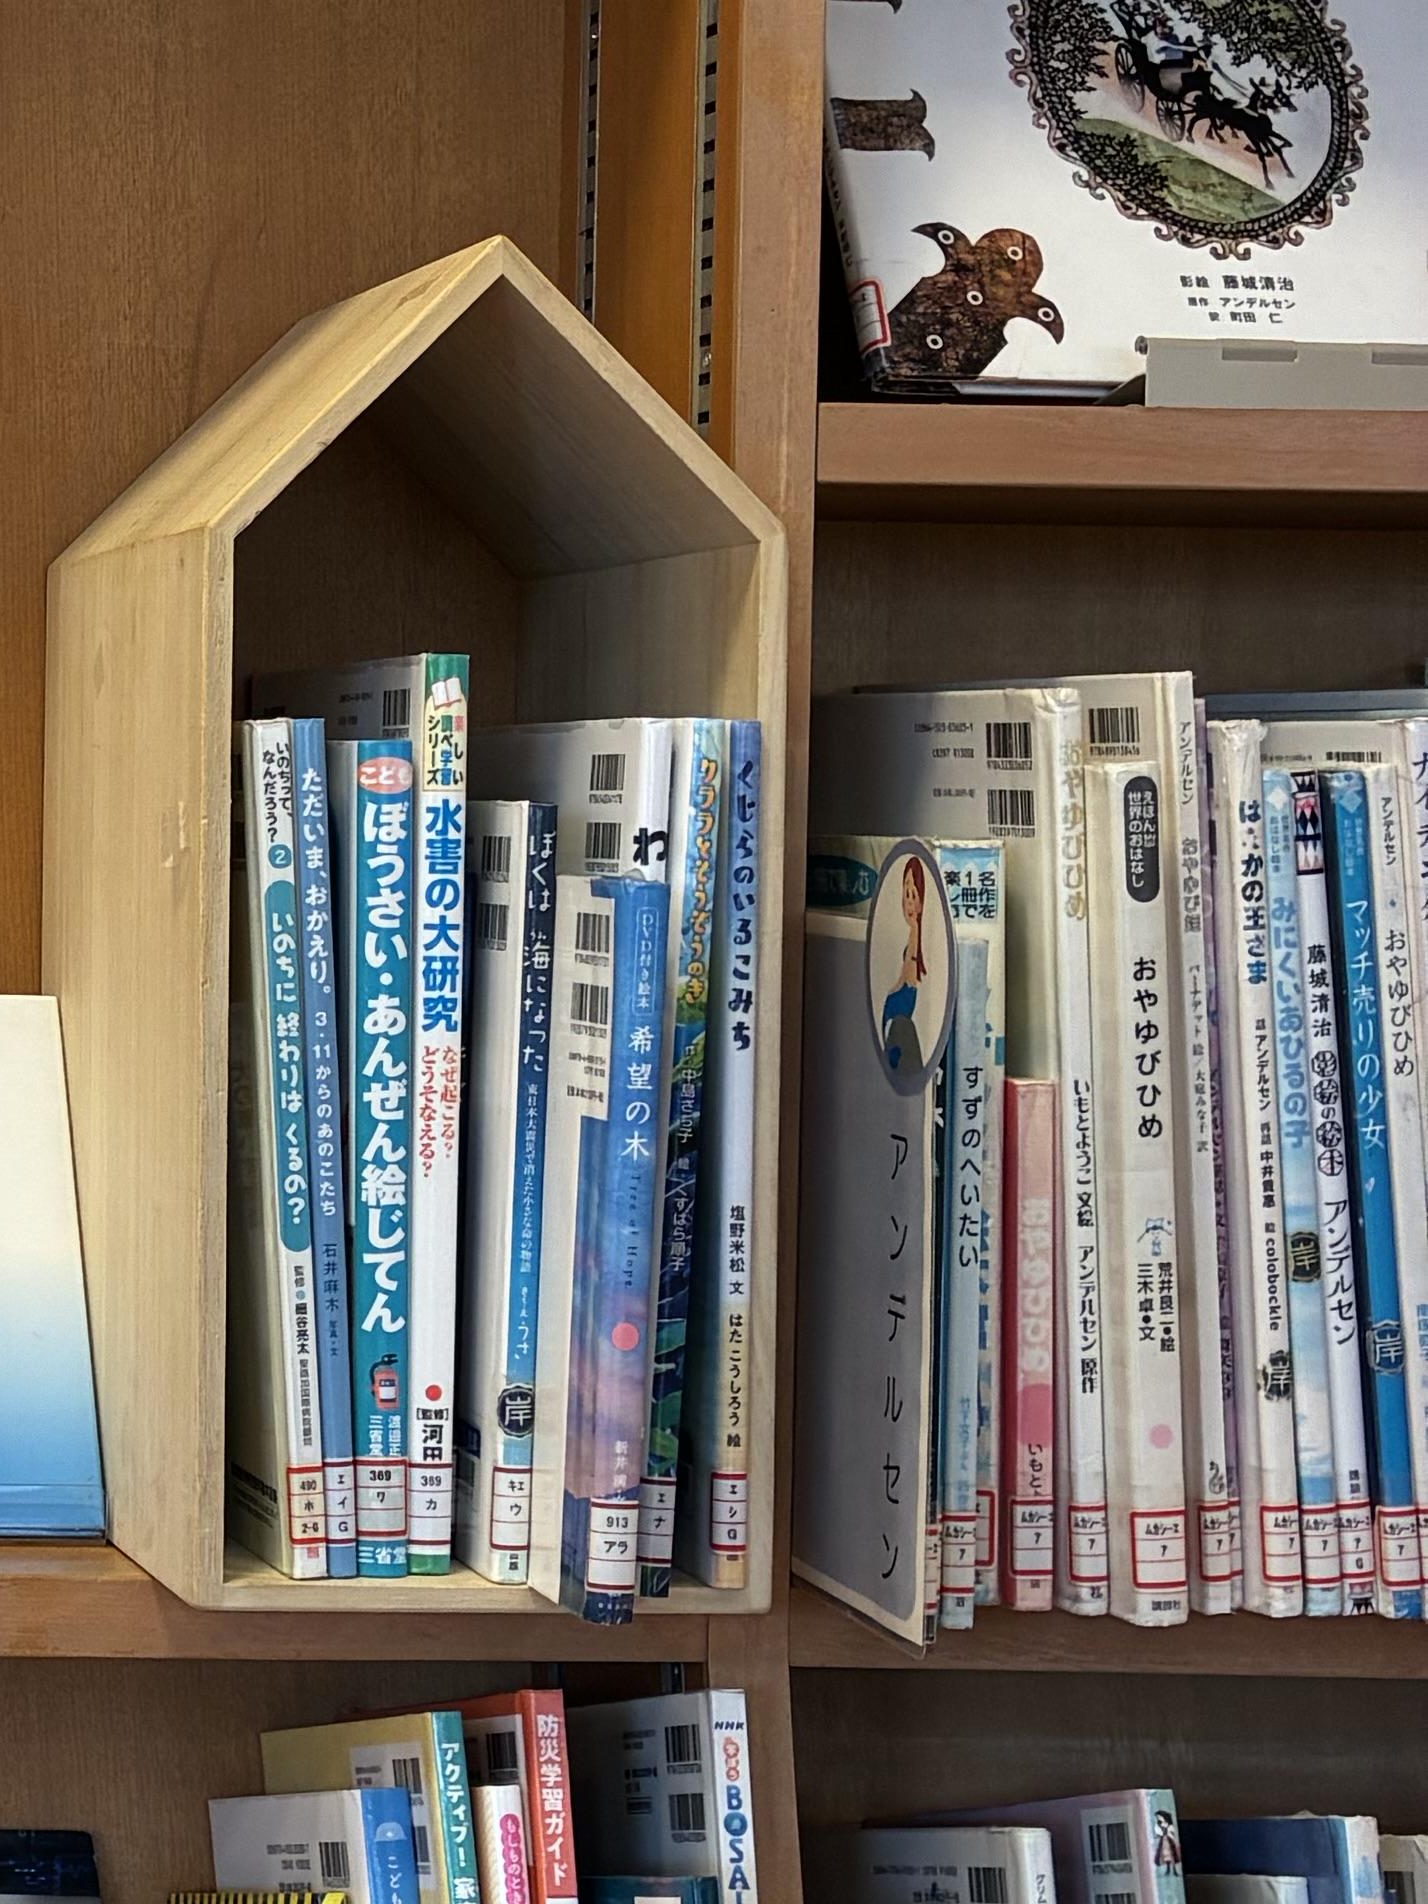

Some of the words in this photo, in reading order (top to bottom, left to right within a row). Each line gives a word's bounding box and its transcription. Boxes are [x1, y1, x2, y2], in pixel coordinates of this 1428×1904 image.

[1219, 297, 1296, 309] アンデルセン
[427, 715, 440, 786] シリーズ
[300, 767, 333, 995] ただいま、おかえり。
[1128, 790, 1145, 888] 世界のおはなし
[1380, 797, 1397, 867] アンデルセン
[272, 912, 296, 1003] いのちに
[421, 797, 464, 1033] 水害の大研究
[276, 1012, 302, 1114] 終わりは
[359, 801, 411, 1334] ぼうさい・あんぜん絵じてん
[521, 944, 552, 1073] 海になった
[1133, 957, 1164, 1140] おやゆびひめ
[1271, 898, 1310, 1148] みにくいあひるの子
[1345, 901, 1386, 1147] マッチ売りの少女
[1385, 928, 1416, 1077] おやゆびひめ
[620, 1026, 655, 1162] 希望の木
[1073, 1080, 1093, 1186] いもとようこ
[1307, 943, 1331, 1039] 藤城清治
[1323, 1199, 1355, 1346] アンデルセン
[956, 1064, 983, 1269] すずのへいたい
[1254, 1034, 1271, 1112] アンデルセン
[1265, 1238, 1281, 1332] colobockle
[322, 1243, 340, 1312] 石井麻木
[729, 1205, 746, 1273] 塩野米松
[1077, 1244, 1098, 1352] アンデルセン
[878, 1130, 912, 1582] アンデルセン
[606, 1513, 629, 1529] 913
[440, 1741, 468, 1869] アクティブ!
[536, 1714, 569, 1887] 防災学習ガイド
